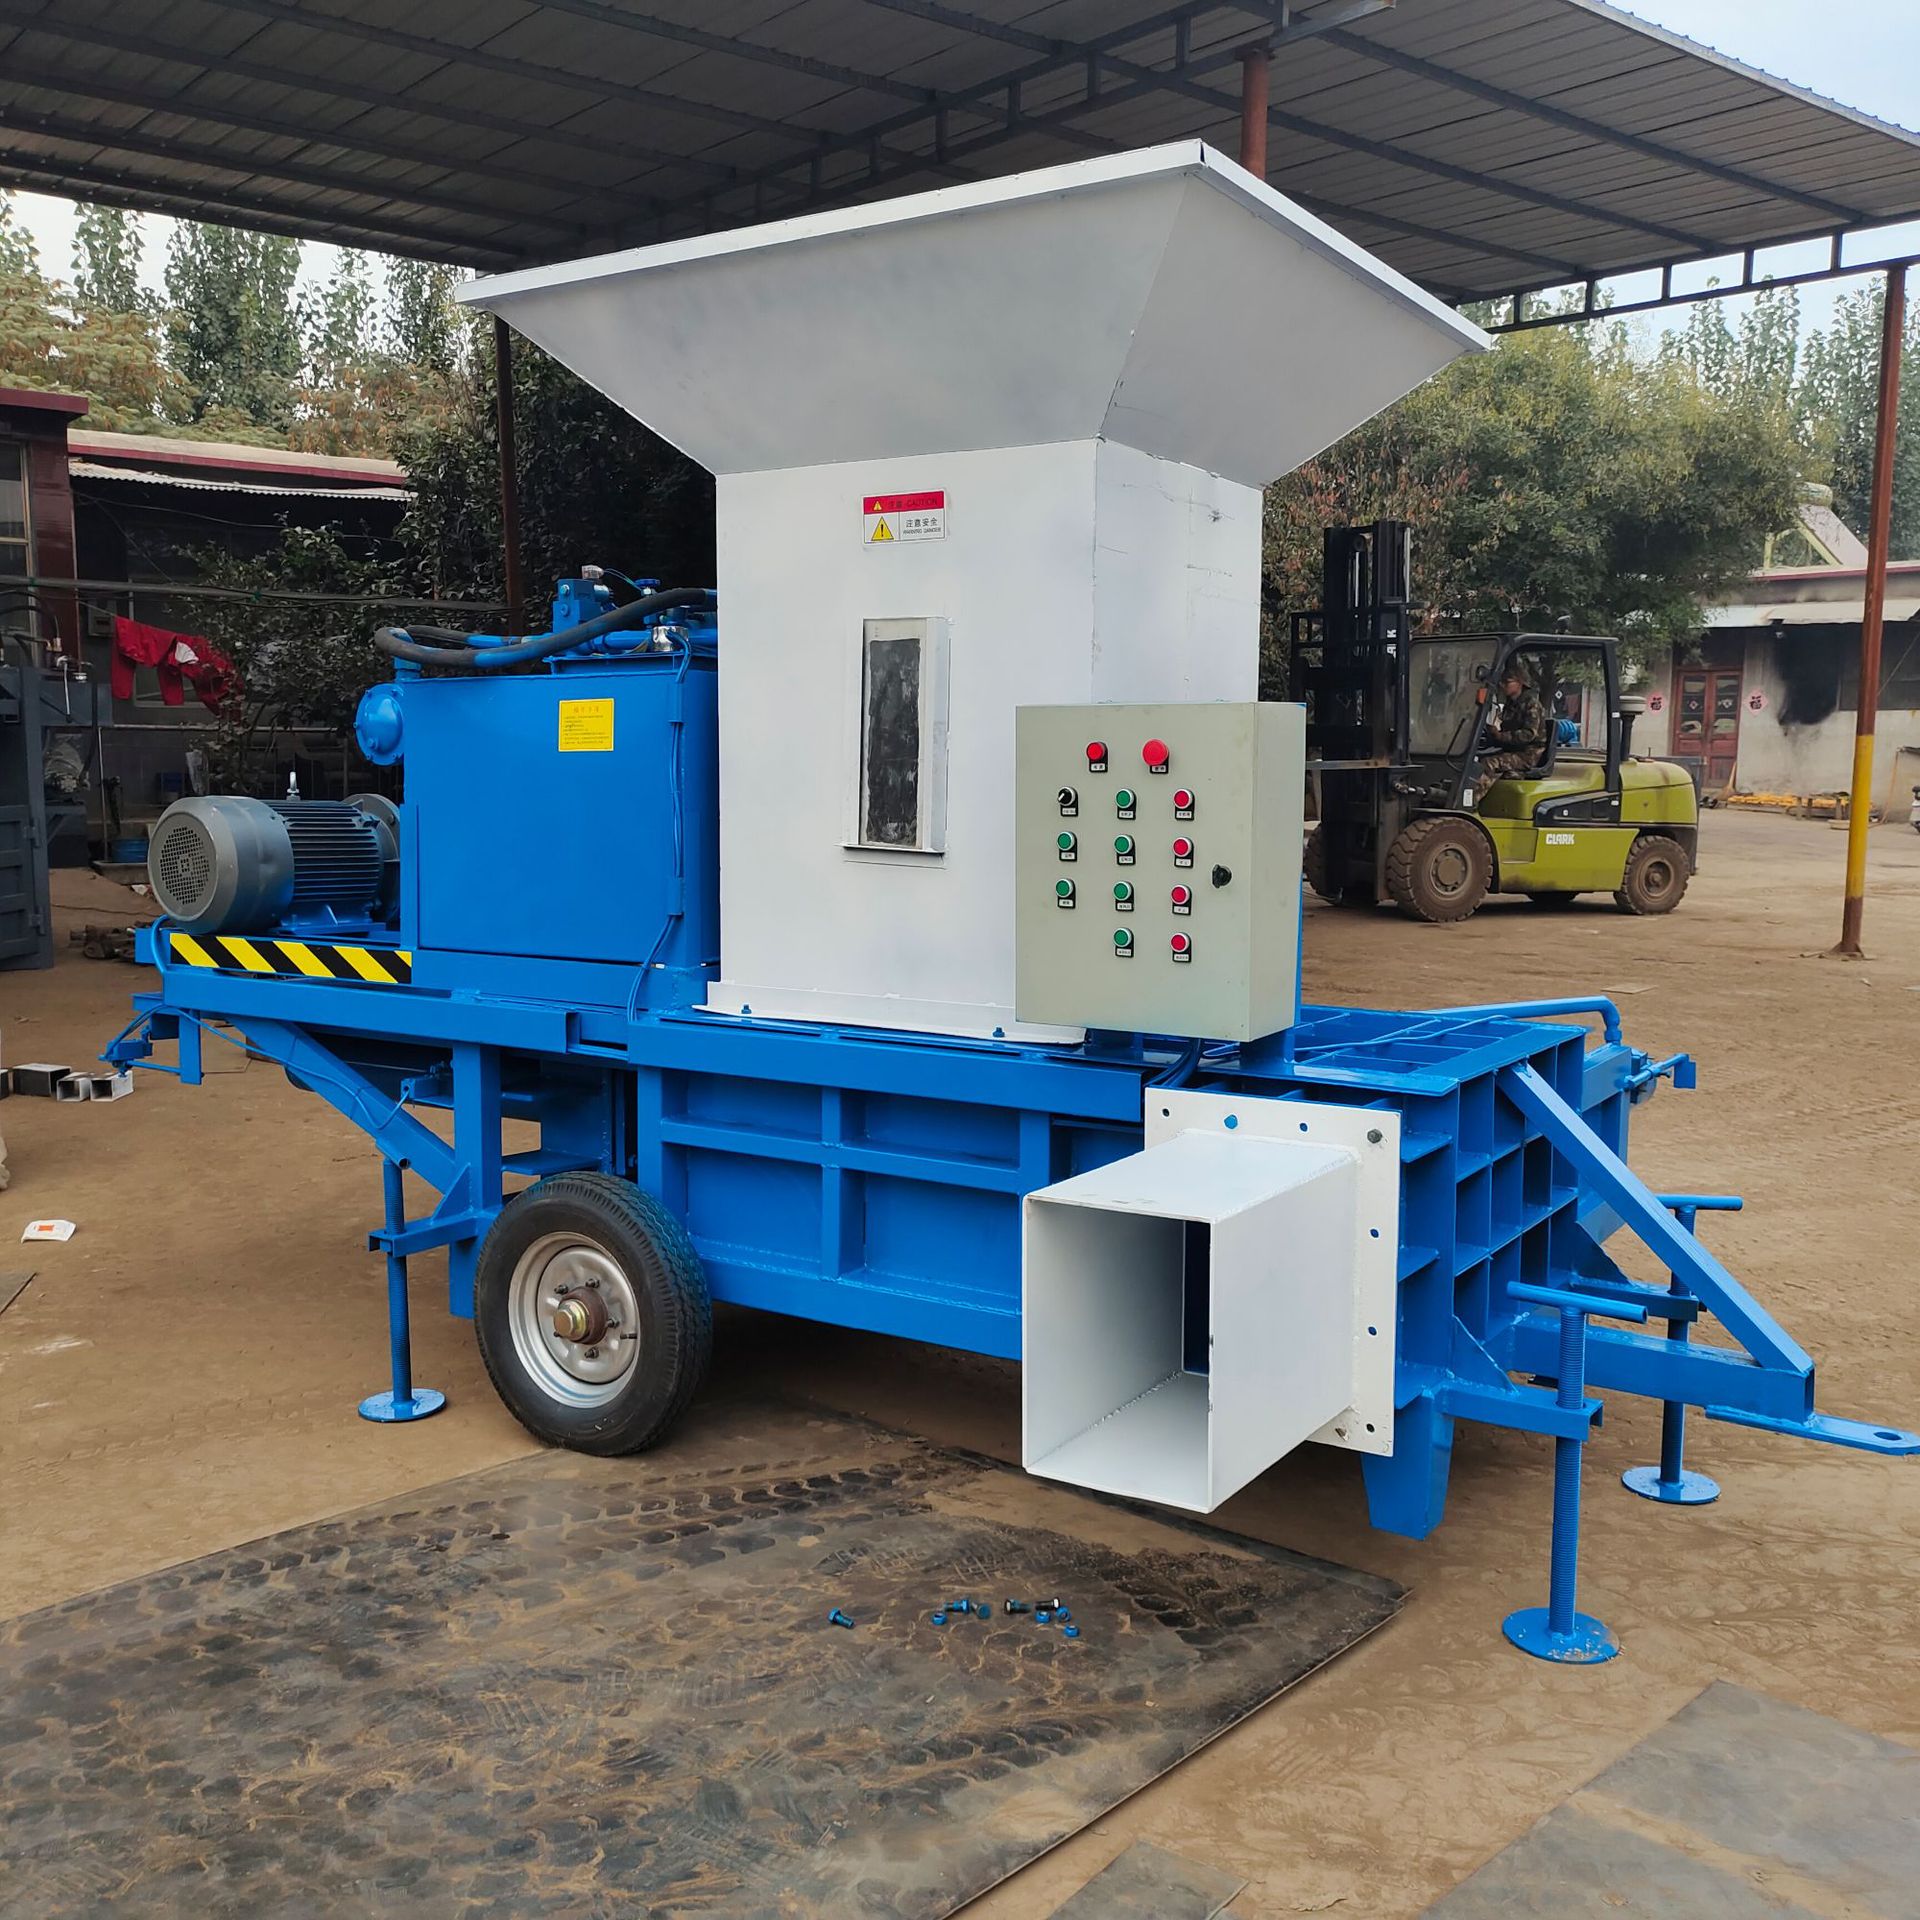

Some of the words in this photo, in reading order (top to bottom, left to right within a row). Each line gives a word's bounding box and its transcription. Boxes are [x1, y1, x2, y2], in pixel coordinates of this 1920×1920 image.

[906, 517, 938, 527] 注意安全
[1546, 833, 1575, 845] CLARK
